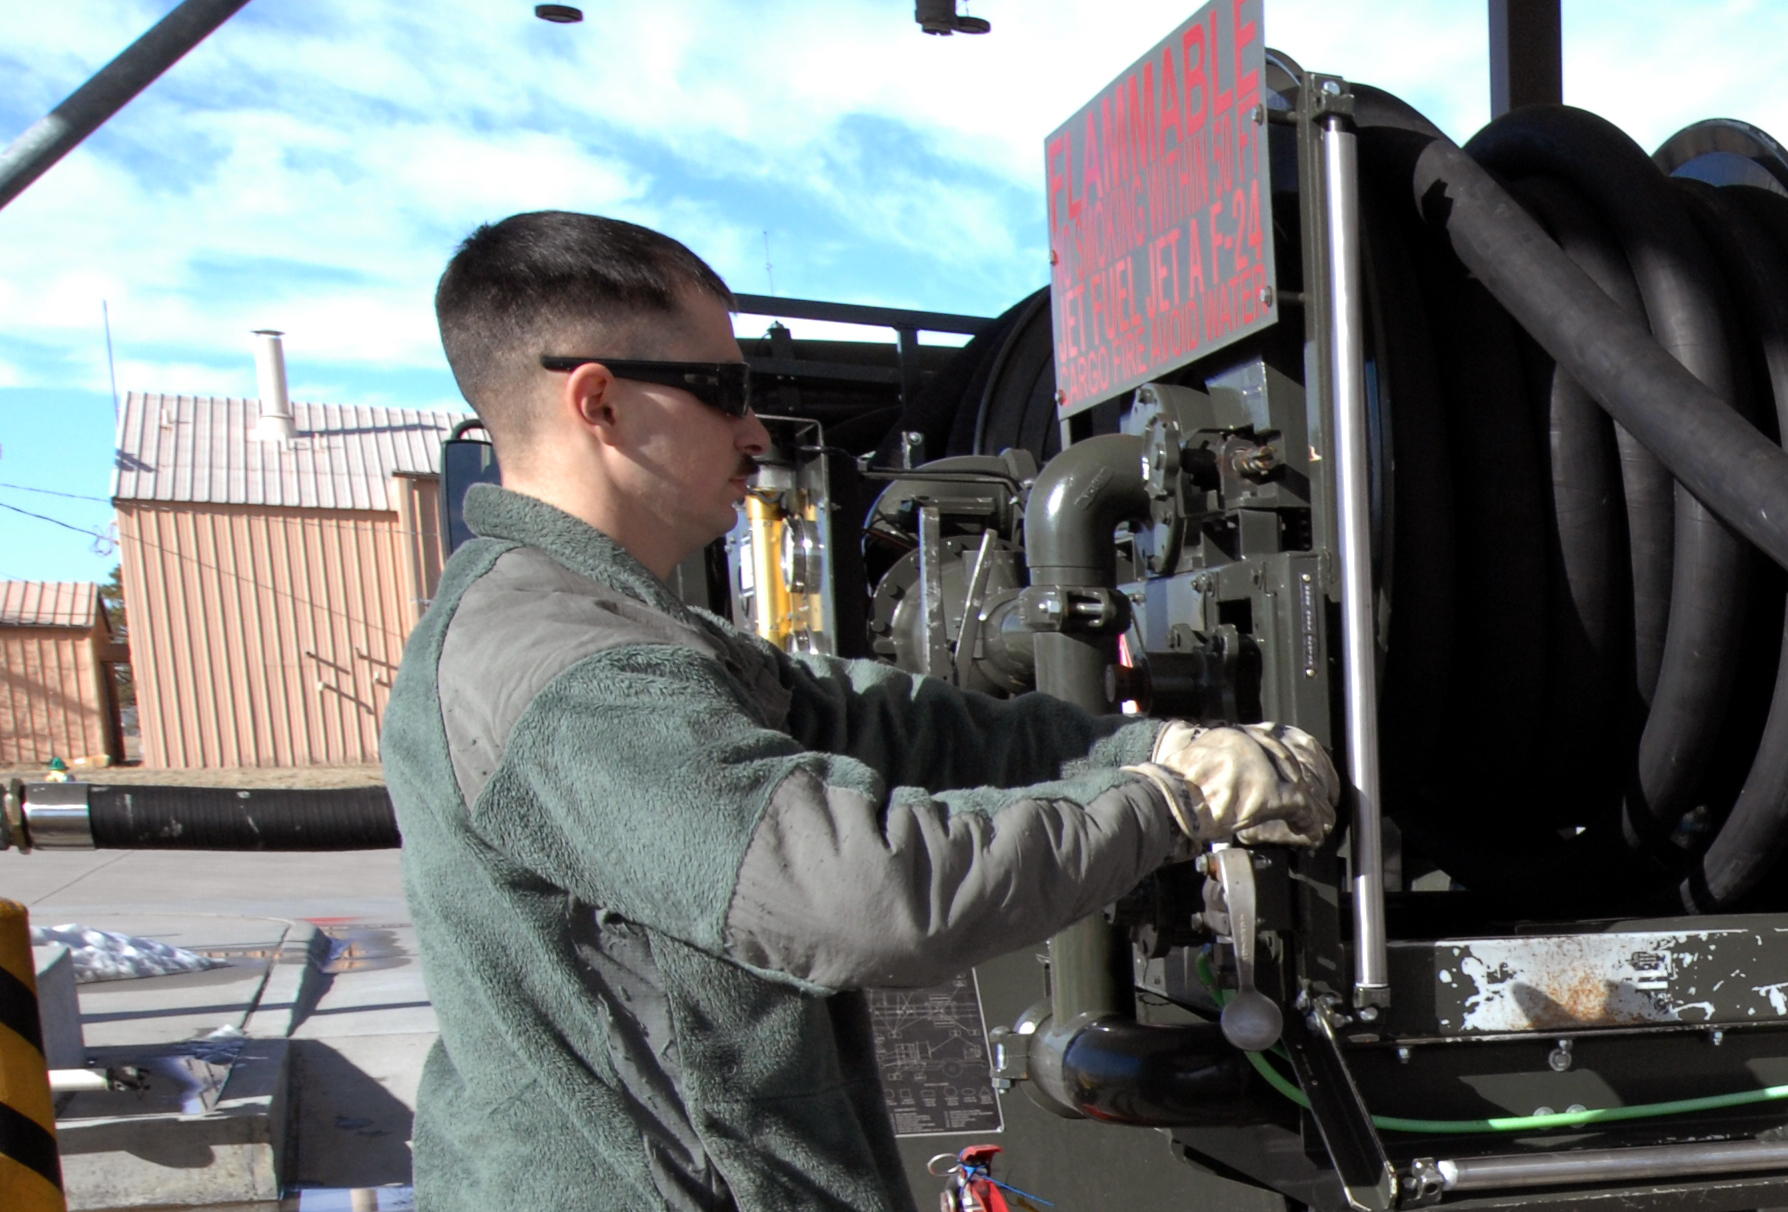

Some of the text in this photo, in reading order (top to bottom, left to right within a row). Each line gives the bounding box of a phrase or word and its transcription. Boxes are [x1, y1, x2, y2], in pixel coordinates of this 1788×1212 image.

[1048, 0, 1259, 232] FLAMMABLE
[1053, 91, 1260, 291] NO SMOKING WITHIN 50 FT
[1060, 178, 1264, 364] JET FUEL JET A F-24
[1060, 262, 1268, 407] CARGO FIRE AVOID WATER
